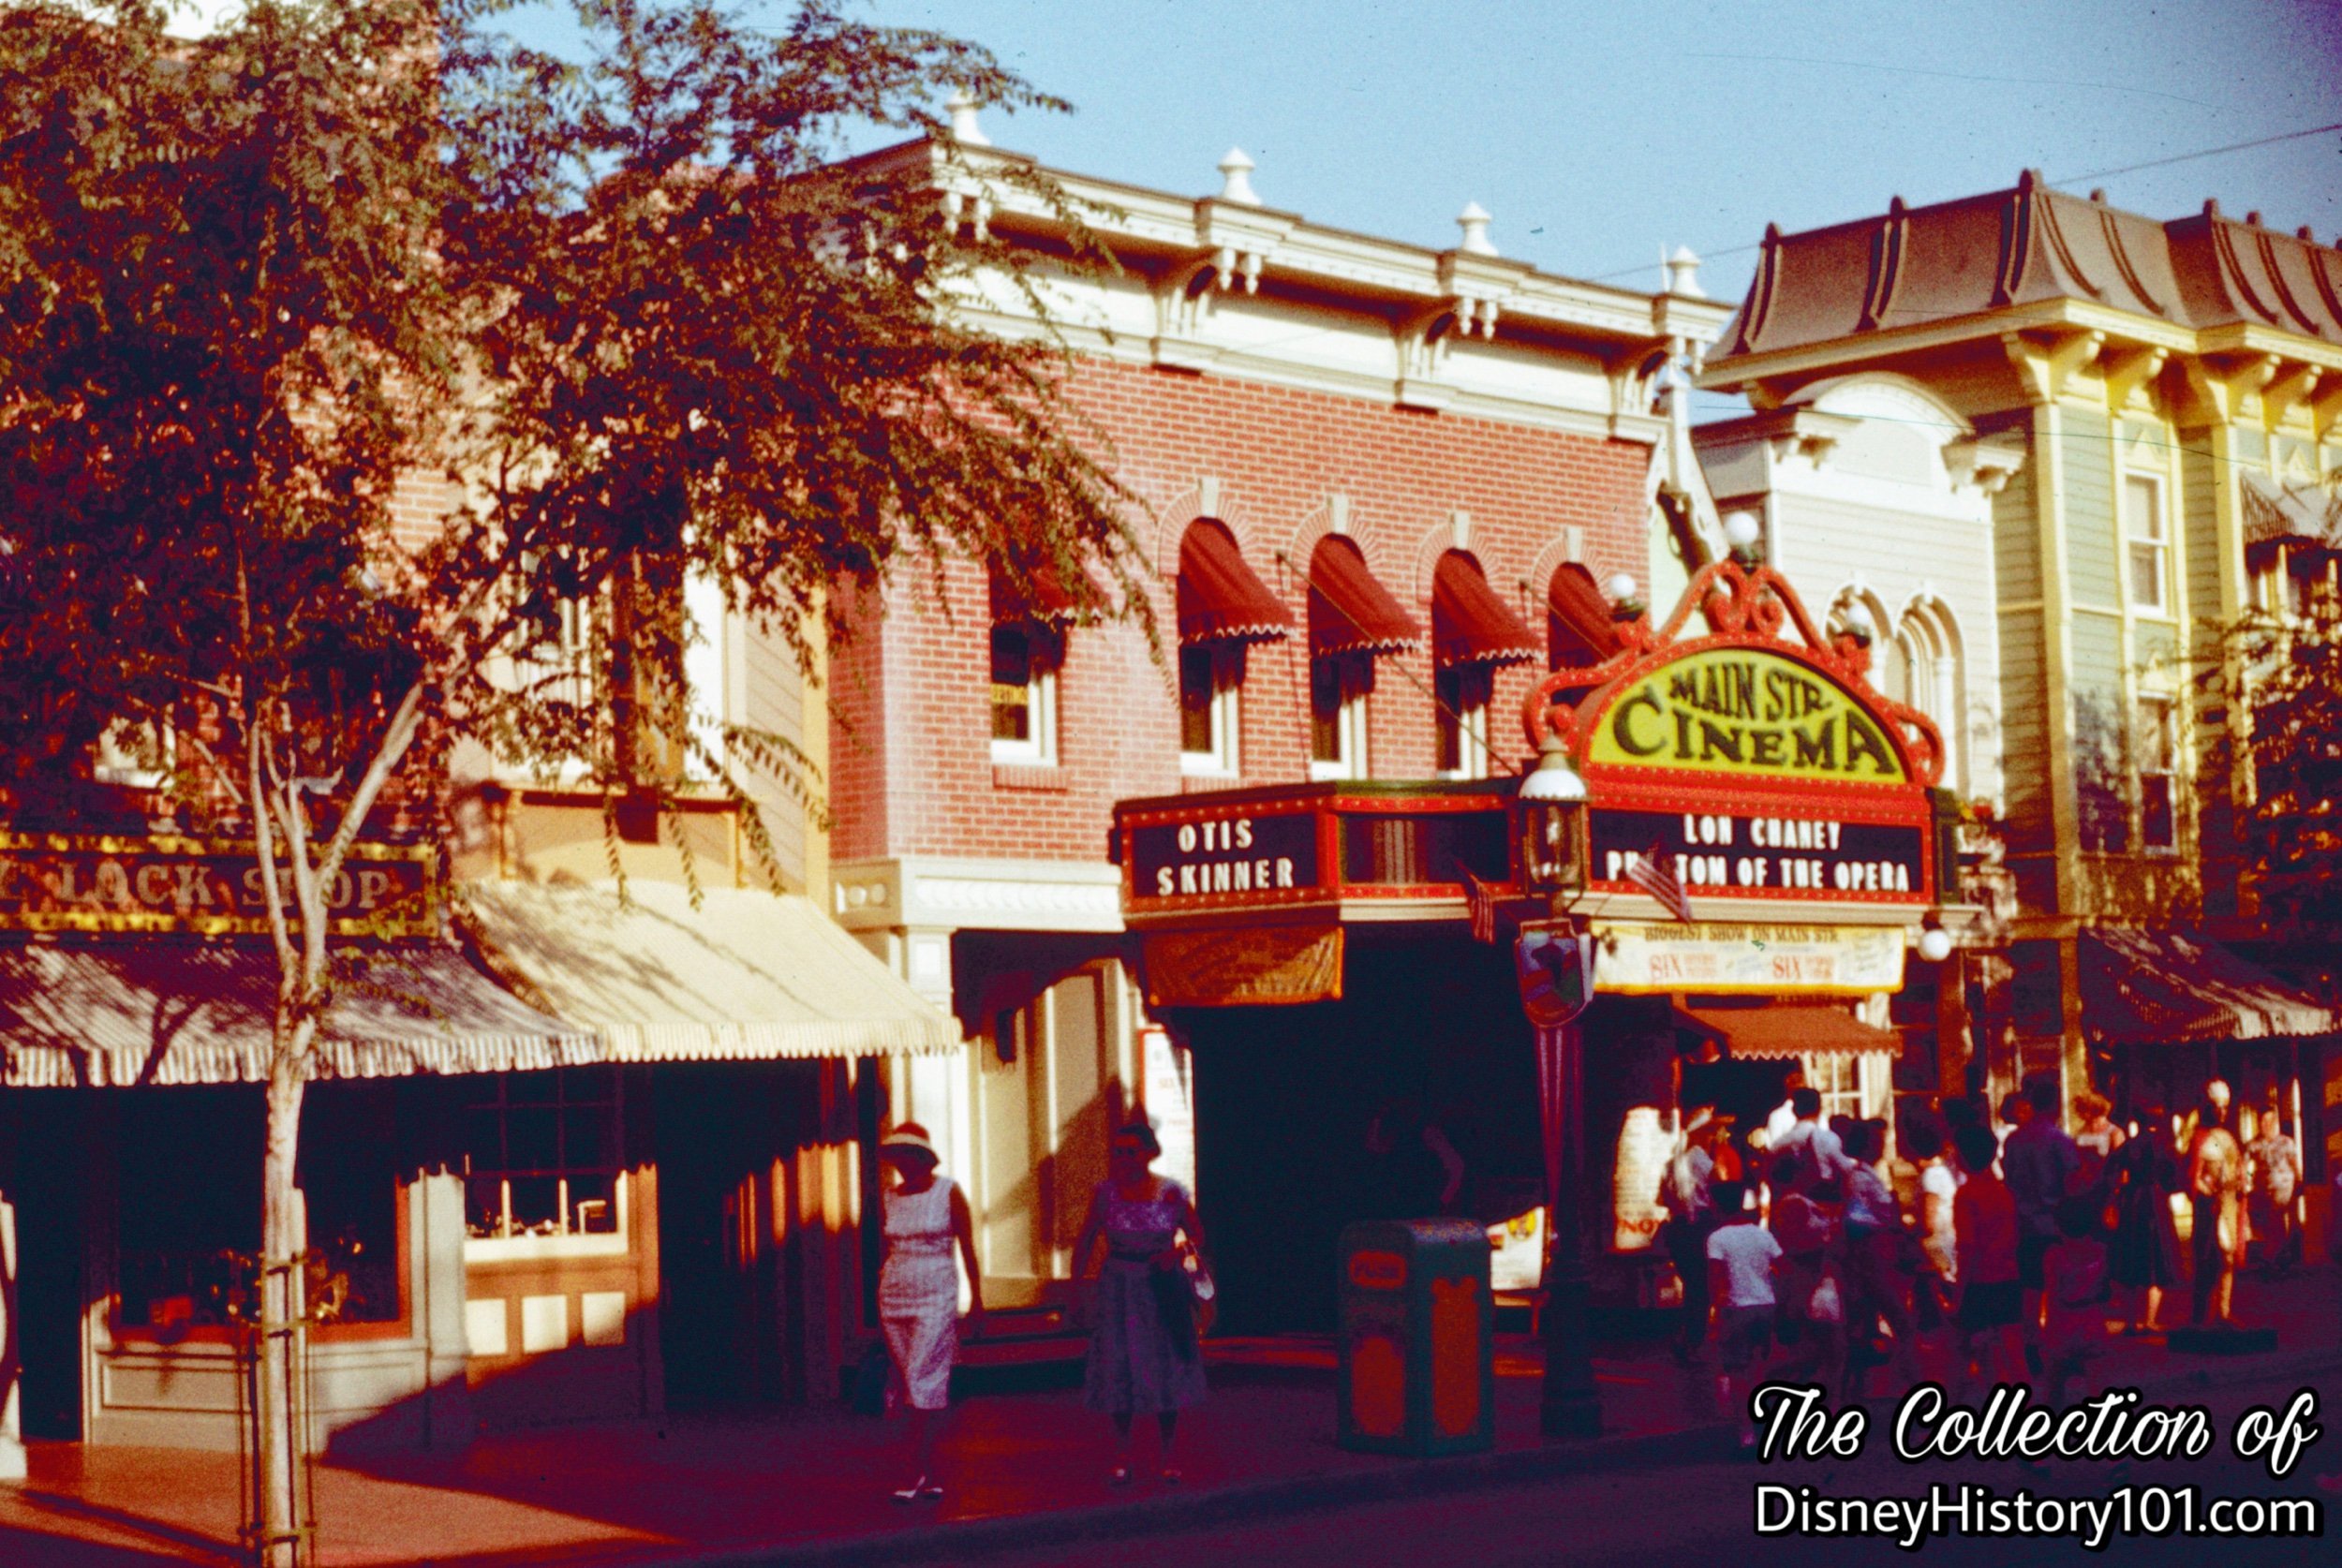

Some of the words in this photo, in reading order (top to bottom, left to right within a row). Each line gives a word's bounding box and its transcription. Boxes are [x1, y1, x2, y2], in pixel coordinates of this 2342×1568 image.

[1669, 662, 1756, 720] MAIN
[1612, 683, 1897, 776] CINEMA
[1178, 818, 1253, 853] OTIS
[1684, 813, 1732, 845] LON
[1750, 817, 1840, 851] CHANEY
[58, 861, 215, 905] LOCK
[1156, 857, 1294, 896] SKINNER
[1607, 851, 1727, 886] PHTOM
[1737, 856, 1768, 887] OF
[1780, 855, 1823, 888] THE
[1833, 861, 1909, 892] OPERA
[1644, 925, 1701, 941] BIGGEST
[1709, 925, 1745, 941] SHOW
[1753, 926, 1770, 941] ON
[1776, 926, 1809, 942] MAIN
